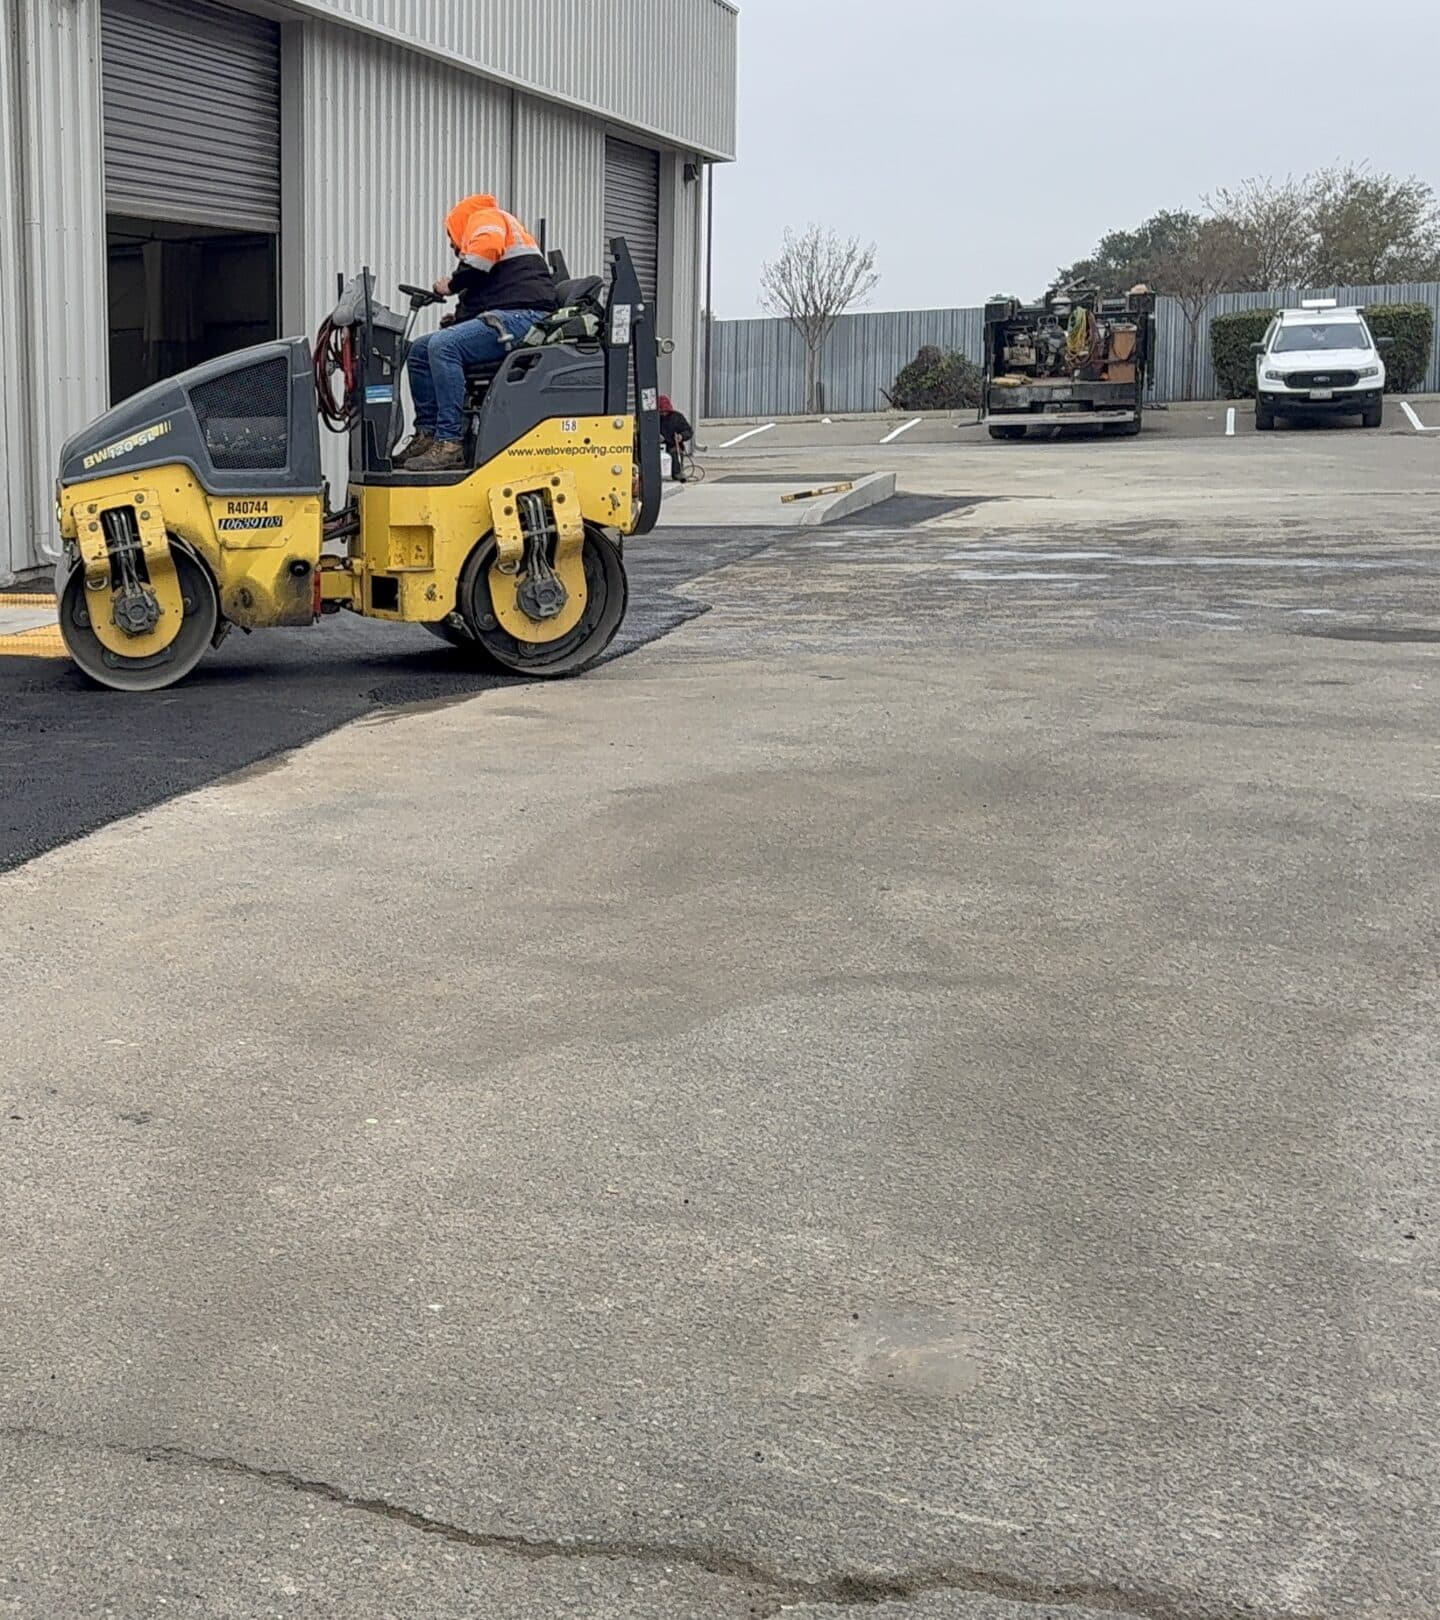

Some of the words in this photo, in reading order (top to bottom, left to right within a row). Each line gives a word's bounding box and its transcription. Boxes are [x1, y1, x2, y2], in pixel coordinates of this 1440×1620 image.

[561, 420, 577, 431] 158
[507, 444, 633, 456] www.welovepaving.com
[227, 501, 268, 514] R40744
